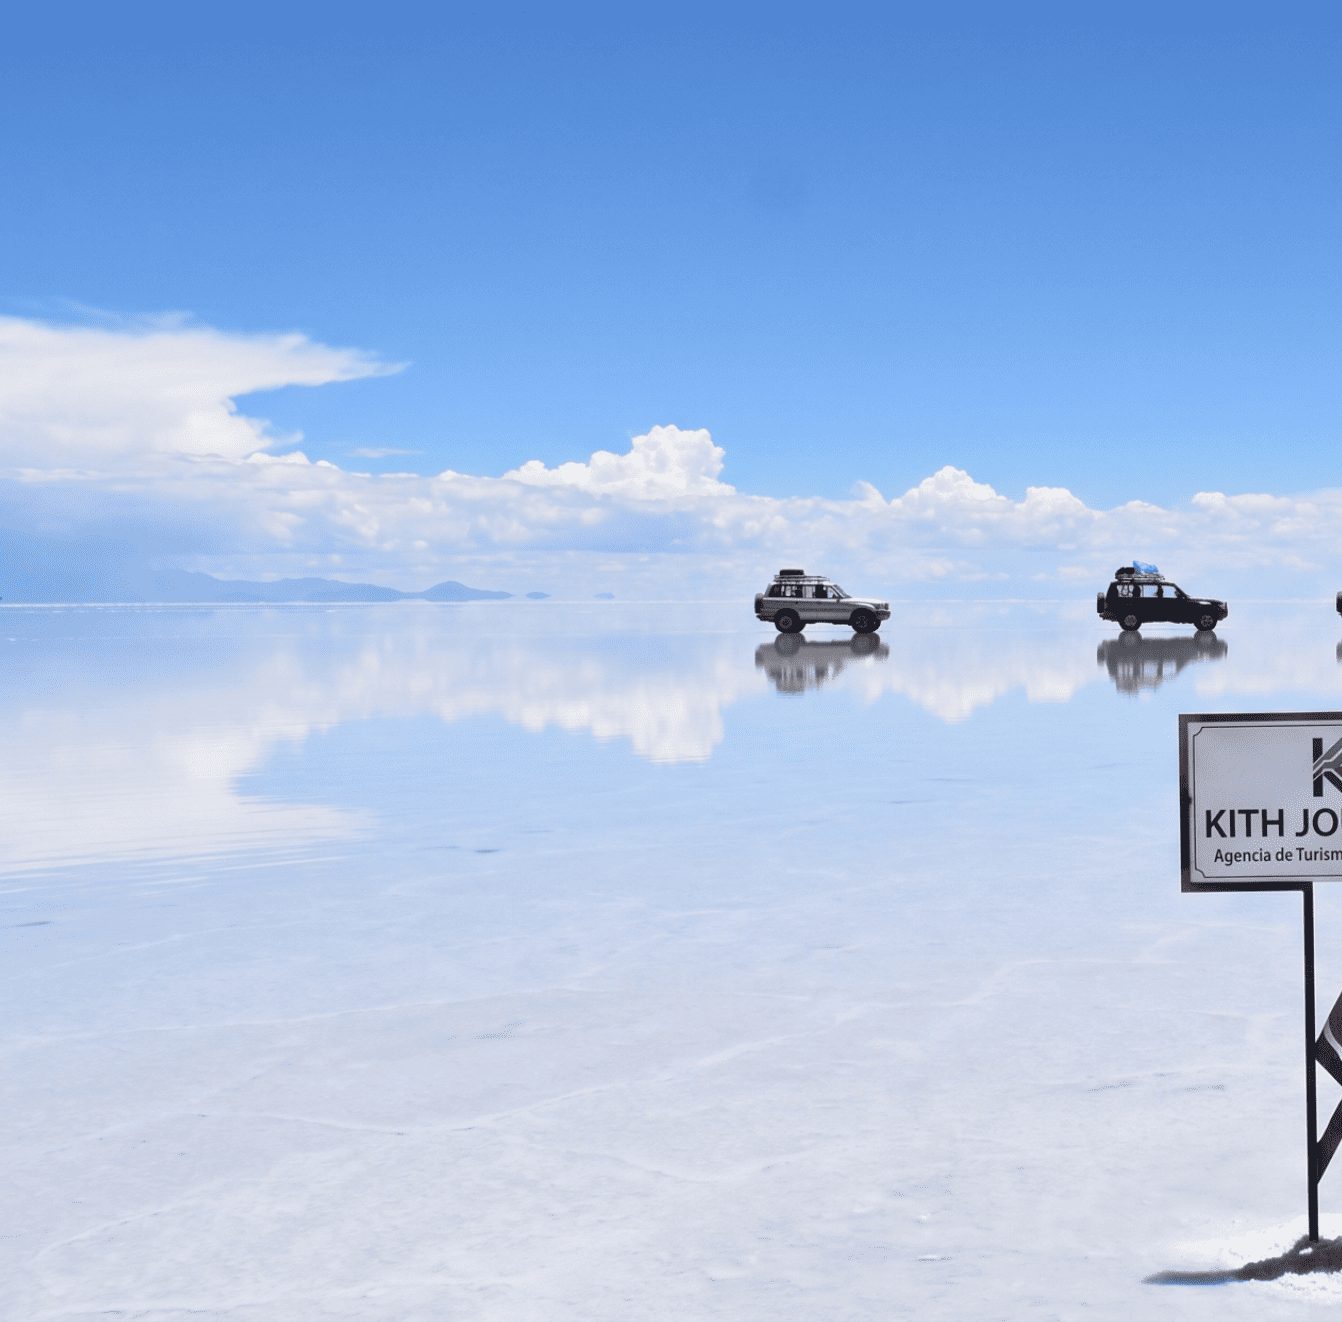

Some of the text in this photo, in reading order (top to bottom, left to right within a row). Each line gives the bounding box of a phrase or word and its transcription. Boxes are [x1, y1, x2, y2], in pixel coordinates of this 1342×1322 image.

[1205, 808, 1285, 839] KITH
[1213, 847, 1272, 867] Agencia
[1275, 846, 1293, 862] de
